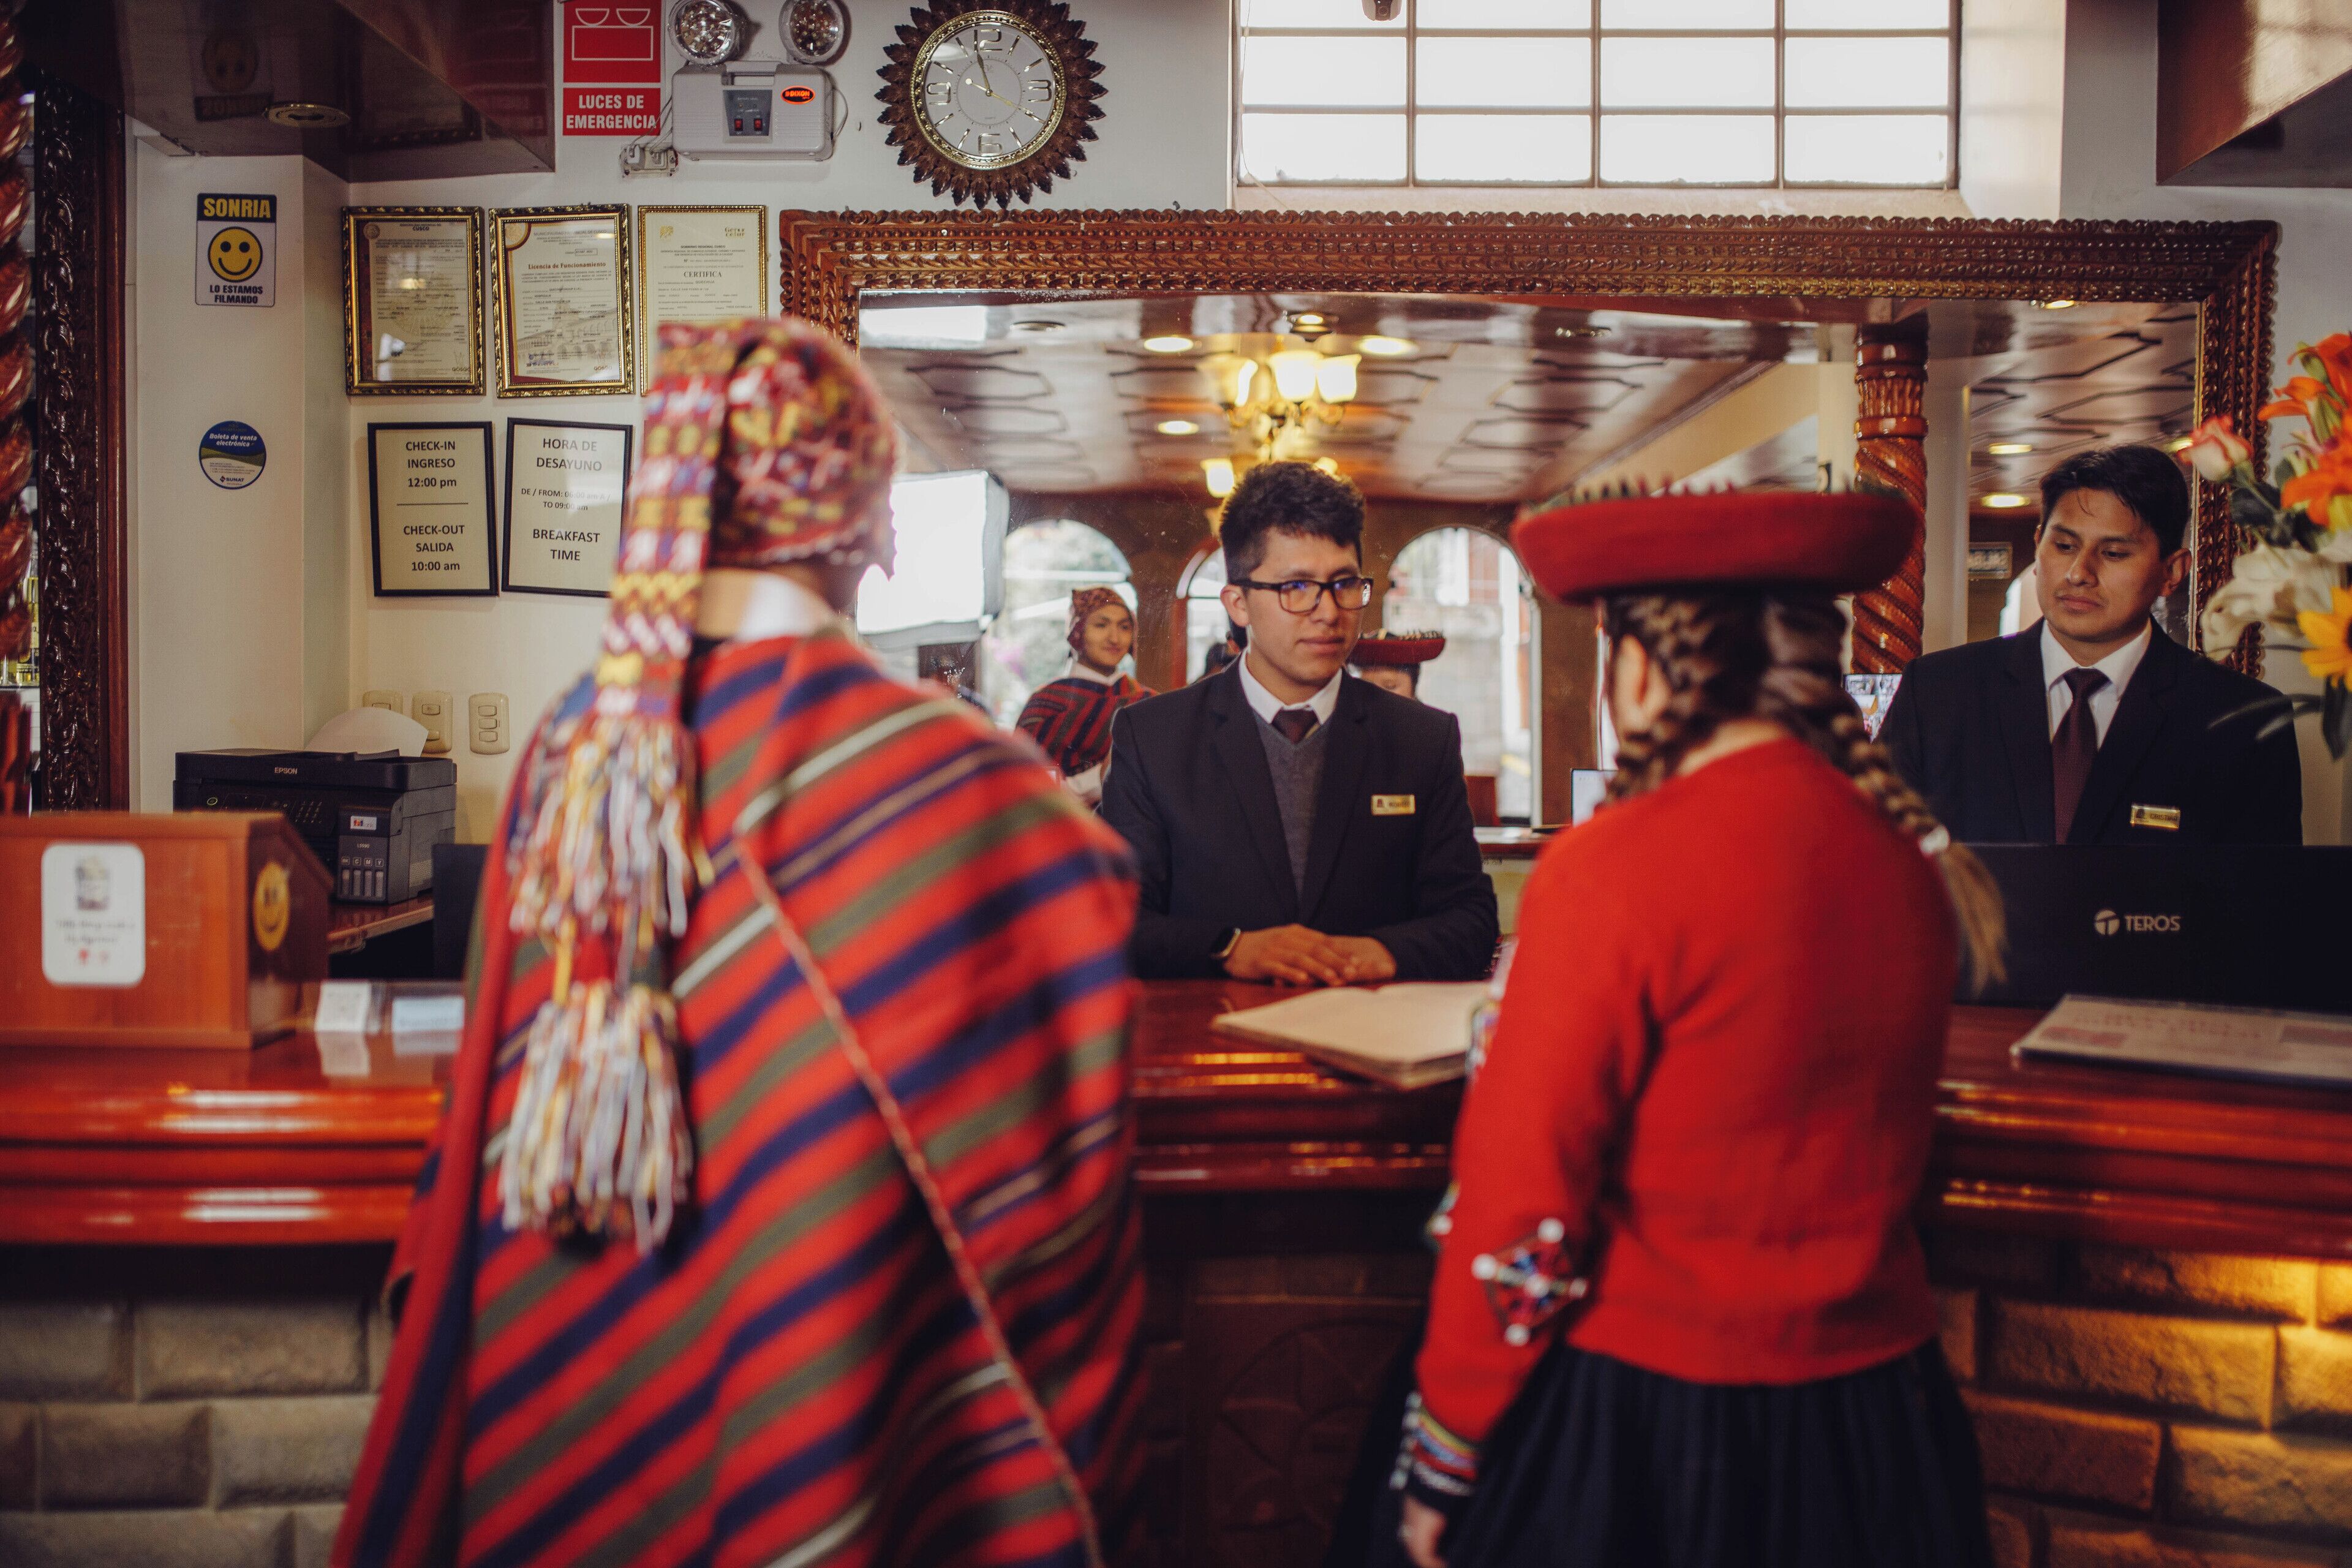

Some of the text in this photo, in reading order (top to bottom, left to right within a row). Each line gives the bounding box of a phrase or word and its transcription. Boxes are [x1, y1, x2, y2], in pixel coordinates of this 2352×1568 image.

[974, 29, 1003, 52] 12
[927, 82, 951, 105] 9
[1027, 79, 1052, 102] 3
[579, 94, 644, 109] LUCES DE
[566, 115, 657, 129] EMERGENCIA
[978, 133, 1003, 154] 6
[203, 198, 271, 218] SONRIA
[209, 285, 263, 295] LO ESTAMOS
[214, 295, 258, 304] FILMANDO
[405, 441, 456, 451] CHECK-IN
[543, 438, 597, 451] HORA DE
[408, 458, 455, 468] INGRESO
[537, 457, 602, 471] DESAYUNO
[408, 478, 457, 488] 12:00 pm
[403, 525, 465, 535] CHECK-OUT
[533, 529, 600, 543] BREAKFAST
[416, 543, 454, 552] SALIDA
[550, 549, 581, 560] TIME
[412, 561, 441, 571] 10:00
[2124, 914, 2181, 932] TEROS
